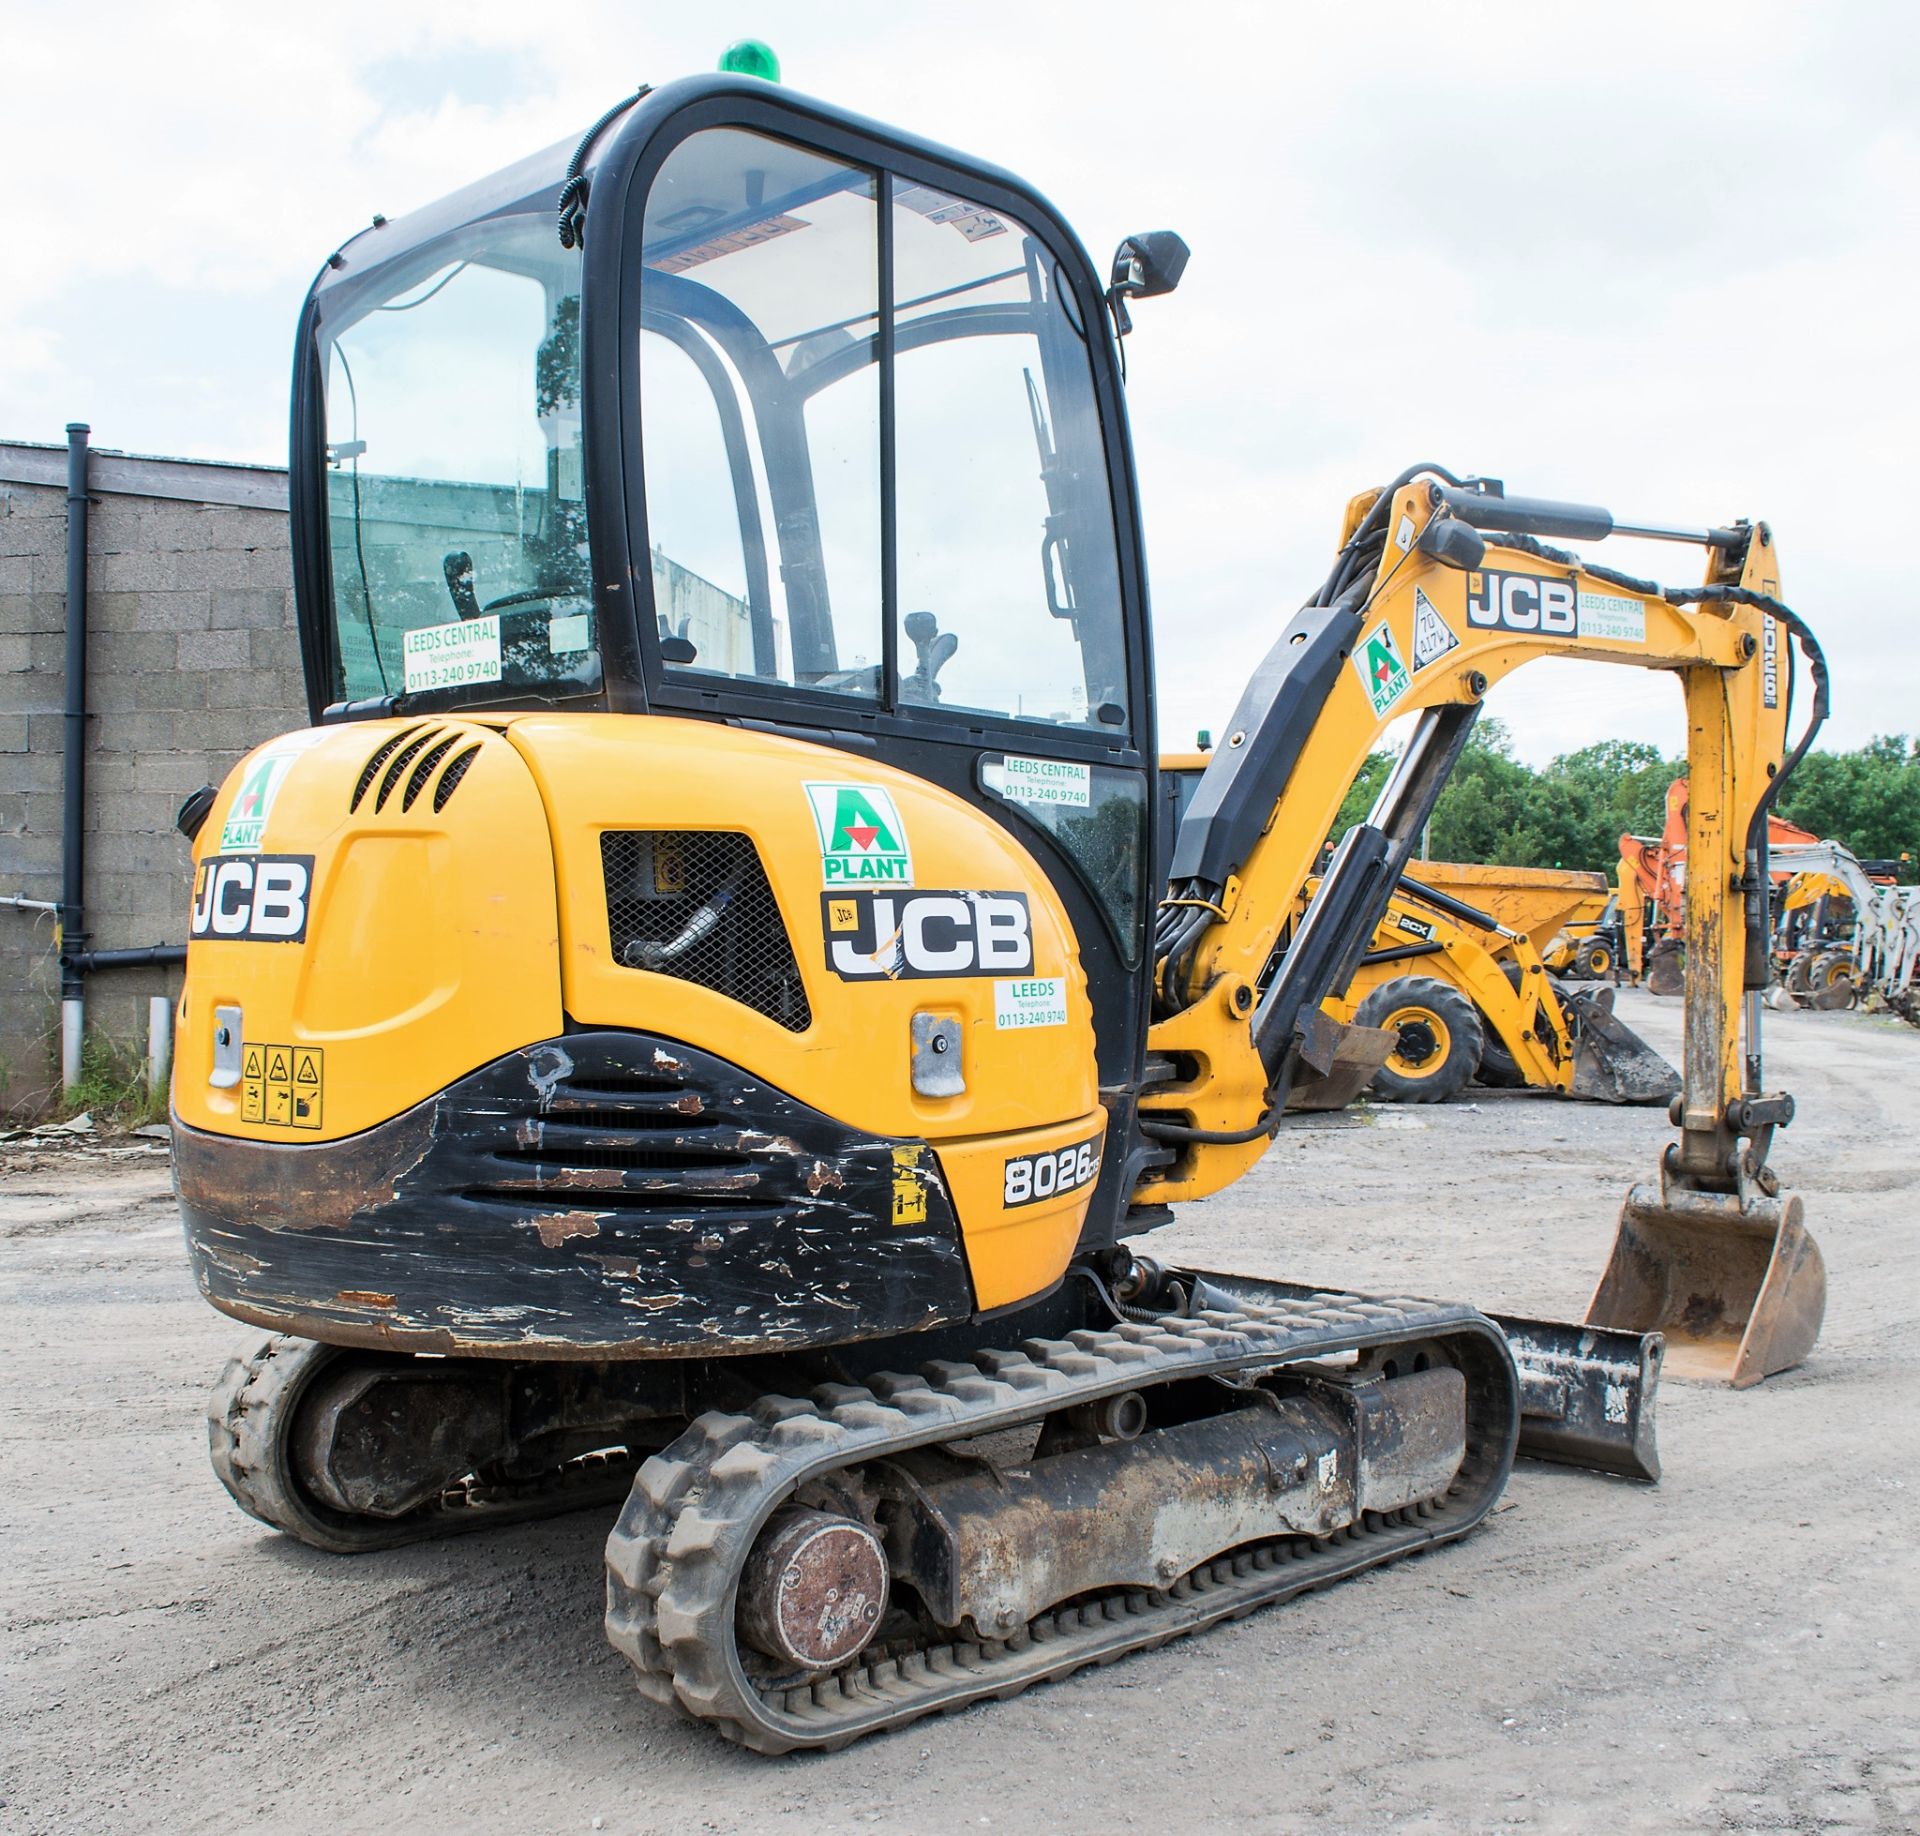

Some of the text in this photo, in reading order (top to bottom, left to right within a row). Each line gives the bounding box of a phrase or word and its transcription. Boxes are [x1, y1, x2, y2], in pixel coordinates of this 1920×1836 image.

[1469, 574, 1576, 633] JCB
[1580, 594, 1644, 616] LEEDS CENTRAL
[408, 630, 441, 653] LEEDS
[443, 620, 497, 647] CENTRAL
[1580, 621, 1644, 640] 0113-240 9740
[409, 666, 464, 689] 0113-240
[467, 660, 498, 679] 9740
[1367, 638, 1402, 695] A
[1374, 671, 1410, 713] PLANT
[1007, 759, 1086, 780] LEEDS CENTRAL
[1005, 785, 1087, 803] 0113-240 9740
[830, 789, 900, 851] A
[223, 823, 262, 844] PLANT
[824, 858, 908, 879] PLANT
[191, 862, 308, 936] JCB
[831, 897, 1031, 974] JCB
[1400, 918, 1428, 936] 2CX
[1012, 982, 1055, 998] LEEDS
[998, 1010, 1066, 1026] 0113-240 9740
